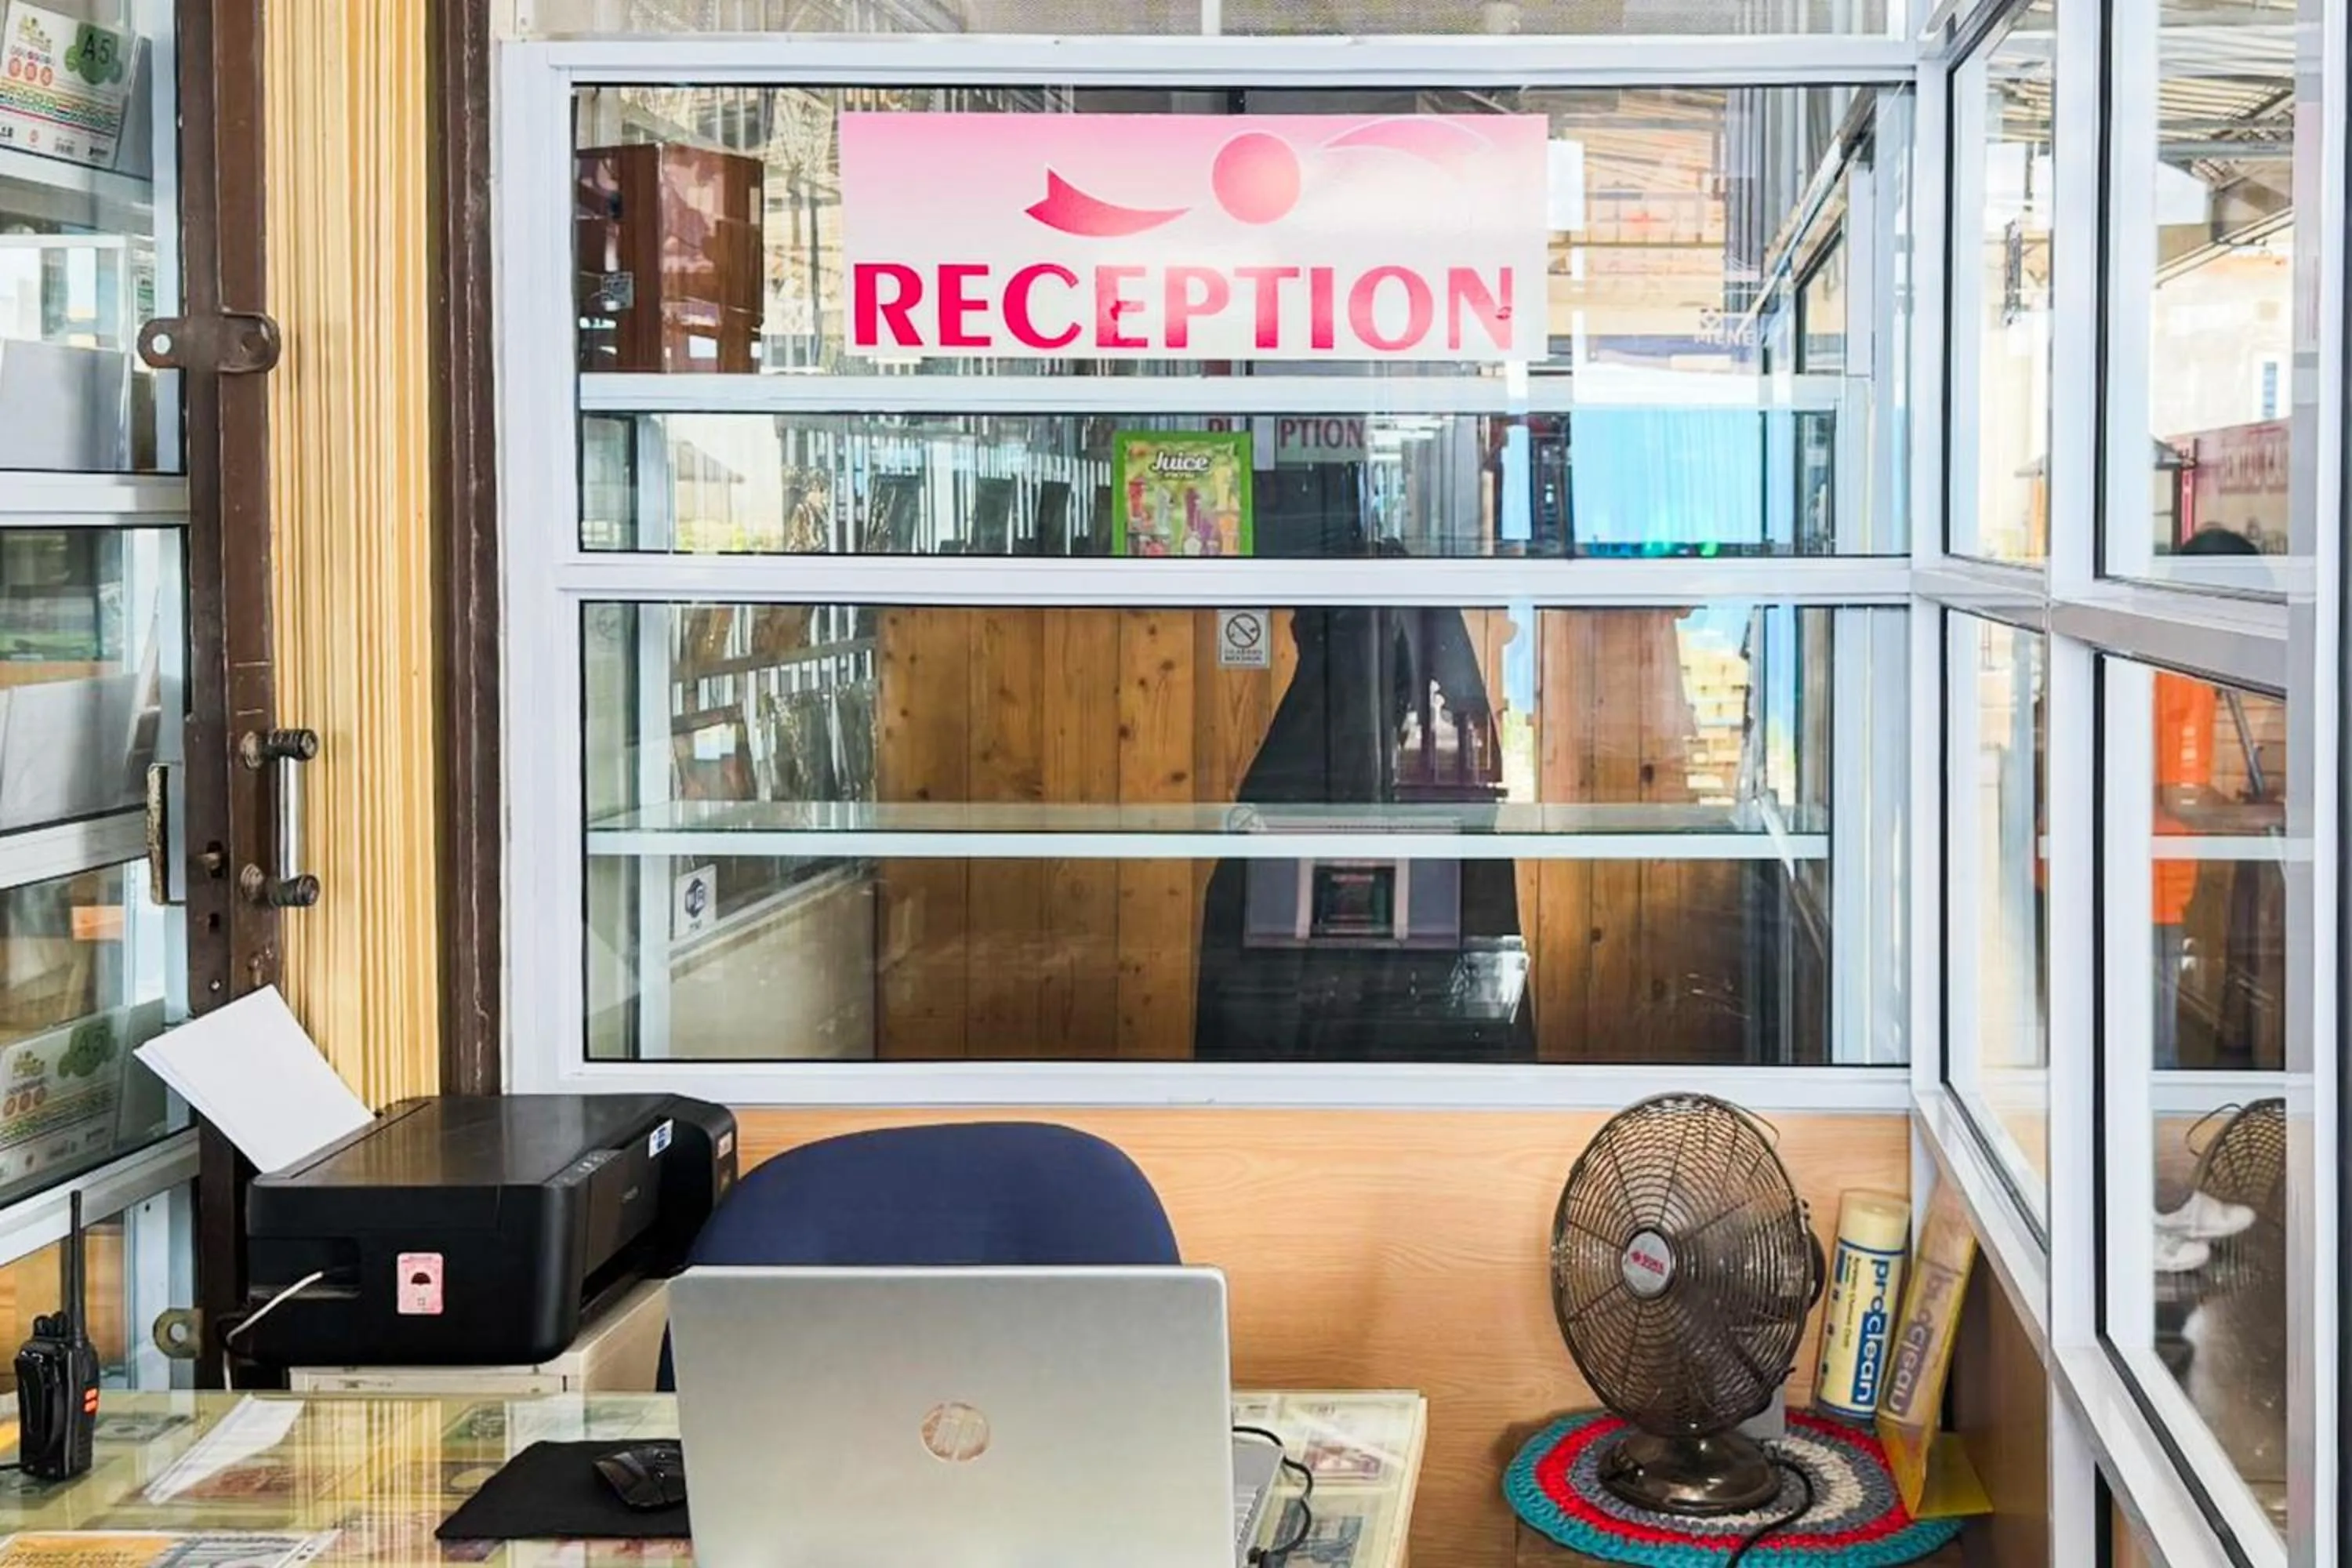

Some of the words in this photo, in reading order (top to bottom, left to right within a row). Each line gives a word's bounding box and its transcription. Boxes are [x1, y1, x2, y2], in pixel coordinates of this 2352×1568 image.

[81, 33, 111, 65] A5
[854, 262, 1513, 350] RECEPTION
[1150, 451, 1209, 471] Juice
[1856, 1258, 1890, 1403] proclean
